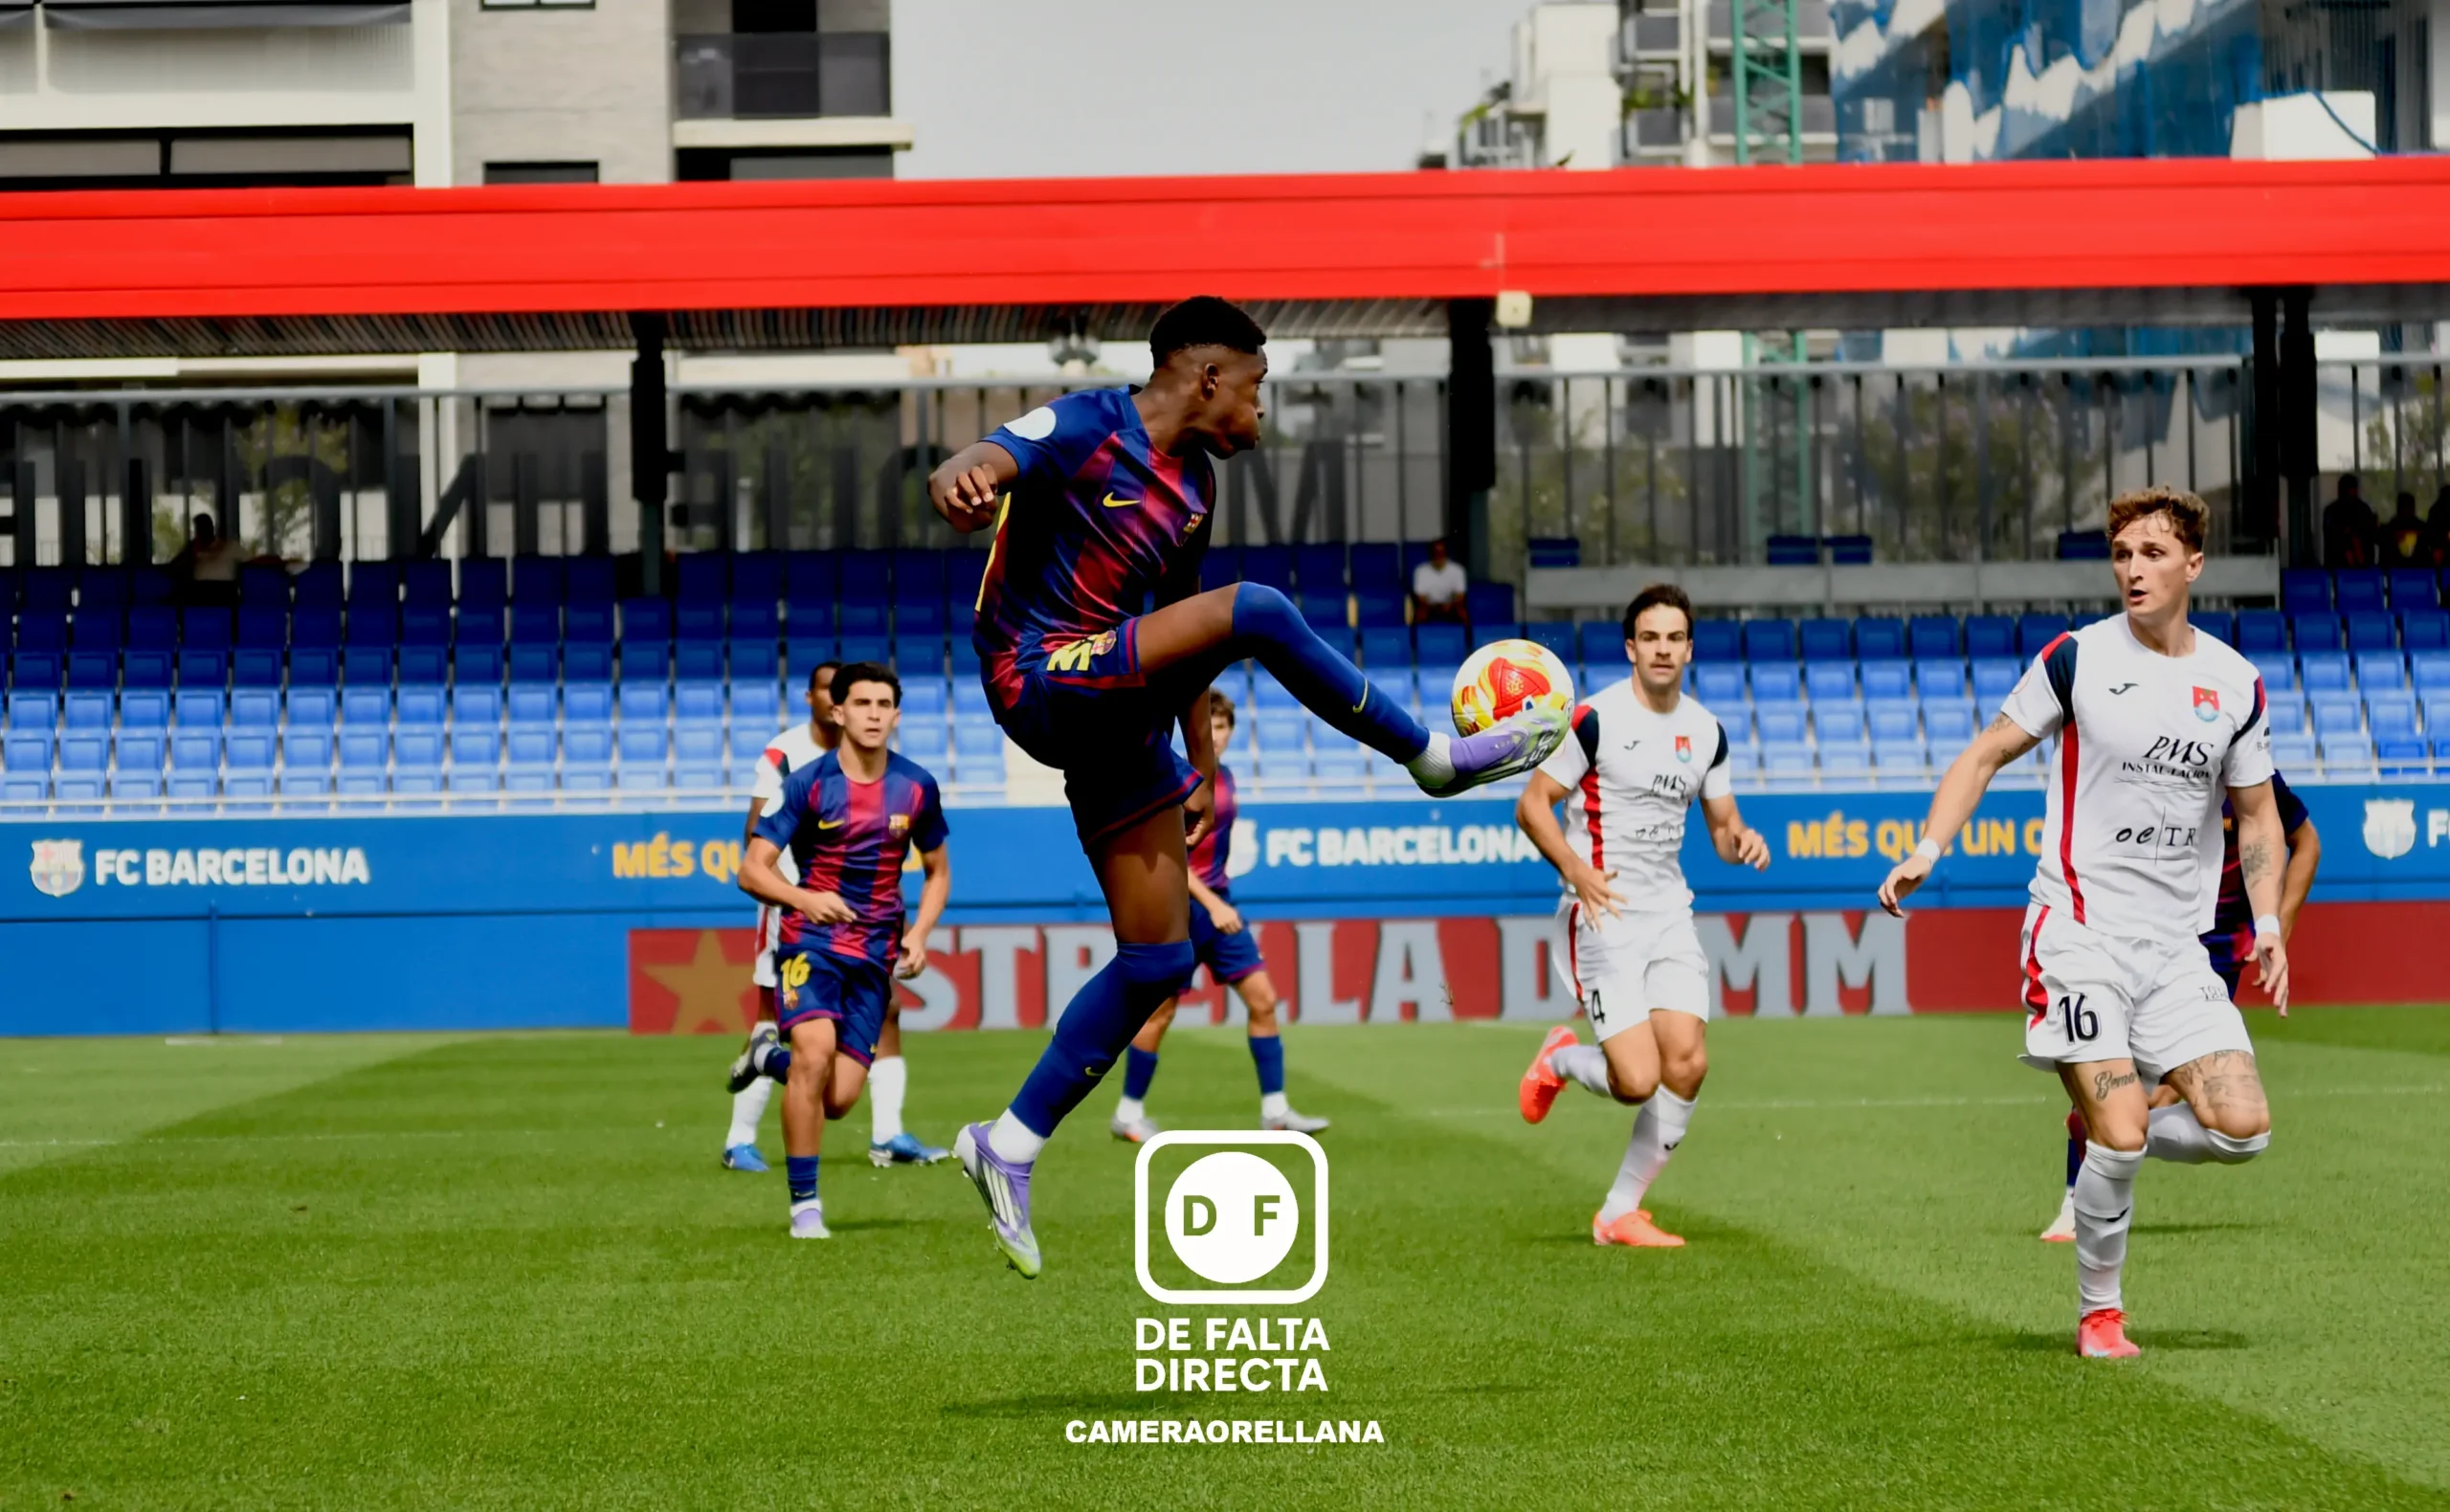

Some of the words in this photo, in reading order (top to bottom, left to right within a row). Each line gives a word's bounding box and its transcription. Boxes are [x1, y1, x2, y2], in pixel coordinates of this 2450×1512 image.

[2142, 735, 2215, 767] PMS
[612, 831, 696, 878] MÉS
[701, 839, 744, 884] QU
[1265, 827, 1315, 868] FC
[1316, 824, 1543, 867] BARCELONA
[1787, 810, 1869, 859] MÉS
[1876, 818, 1953, 863] QU
[1961, 817, 2016, 856] UN
[95, 848, 142, 886] FC
[146, 846, 370, 886] BARCELONA
[780, 951, 812, 992] 16
[1501, 911, 1906, 1020] DMM
[2058, 992, 2102, 1045] 16
